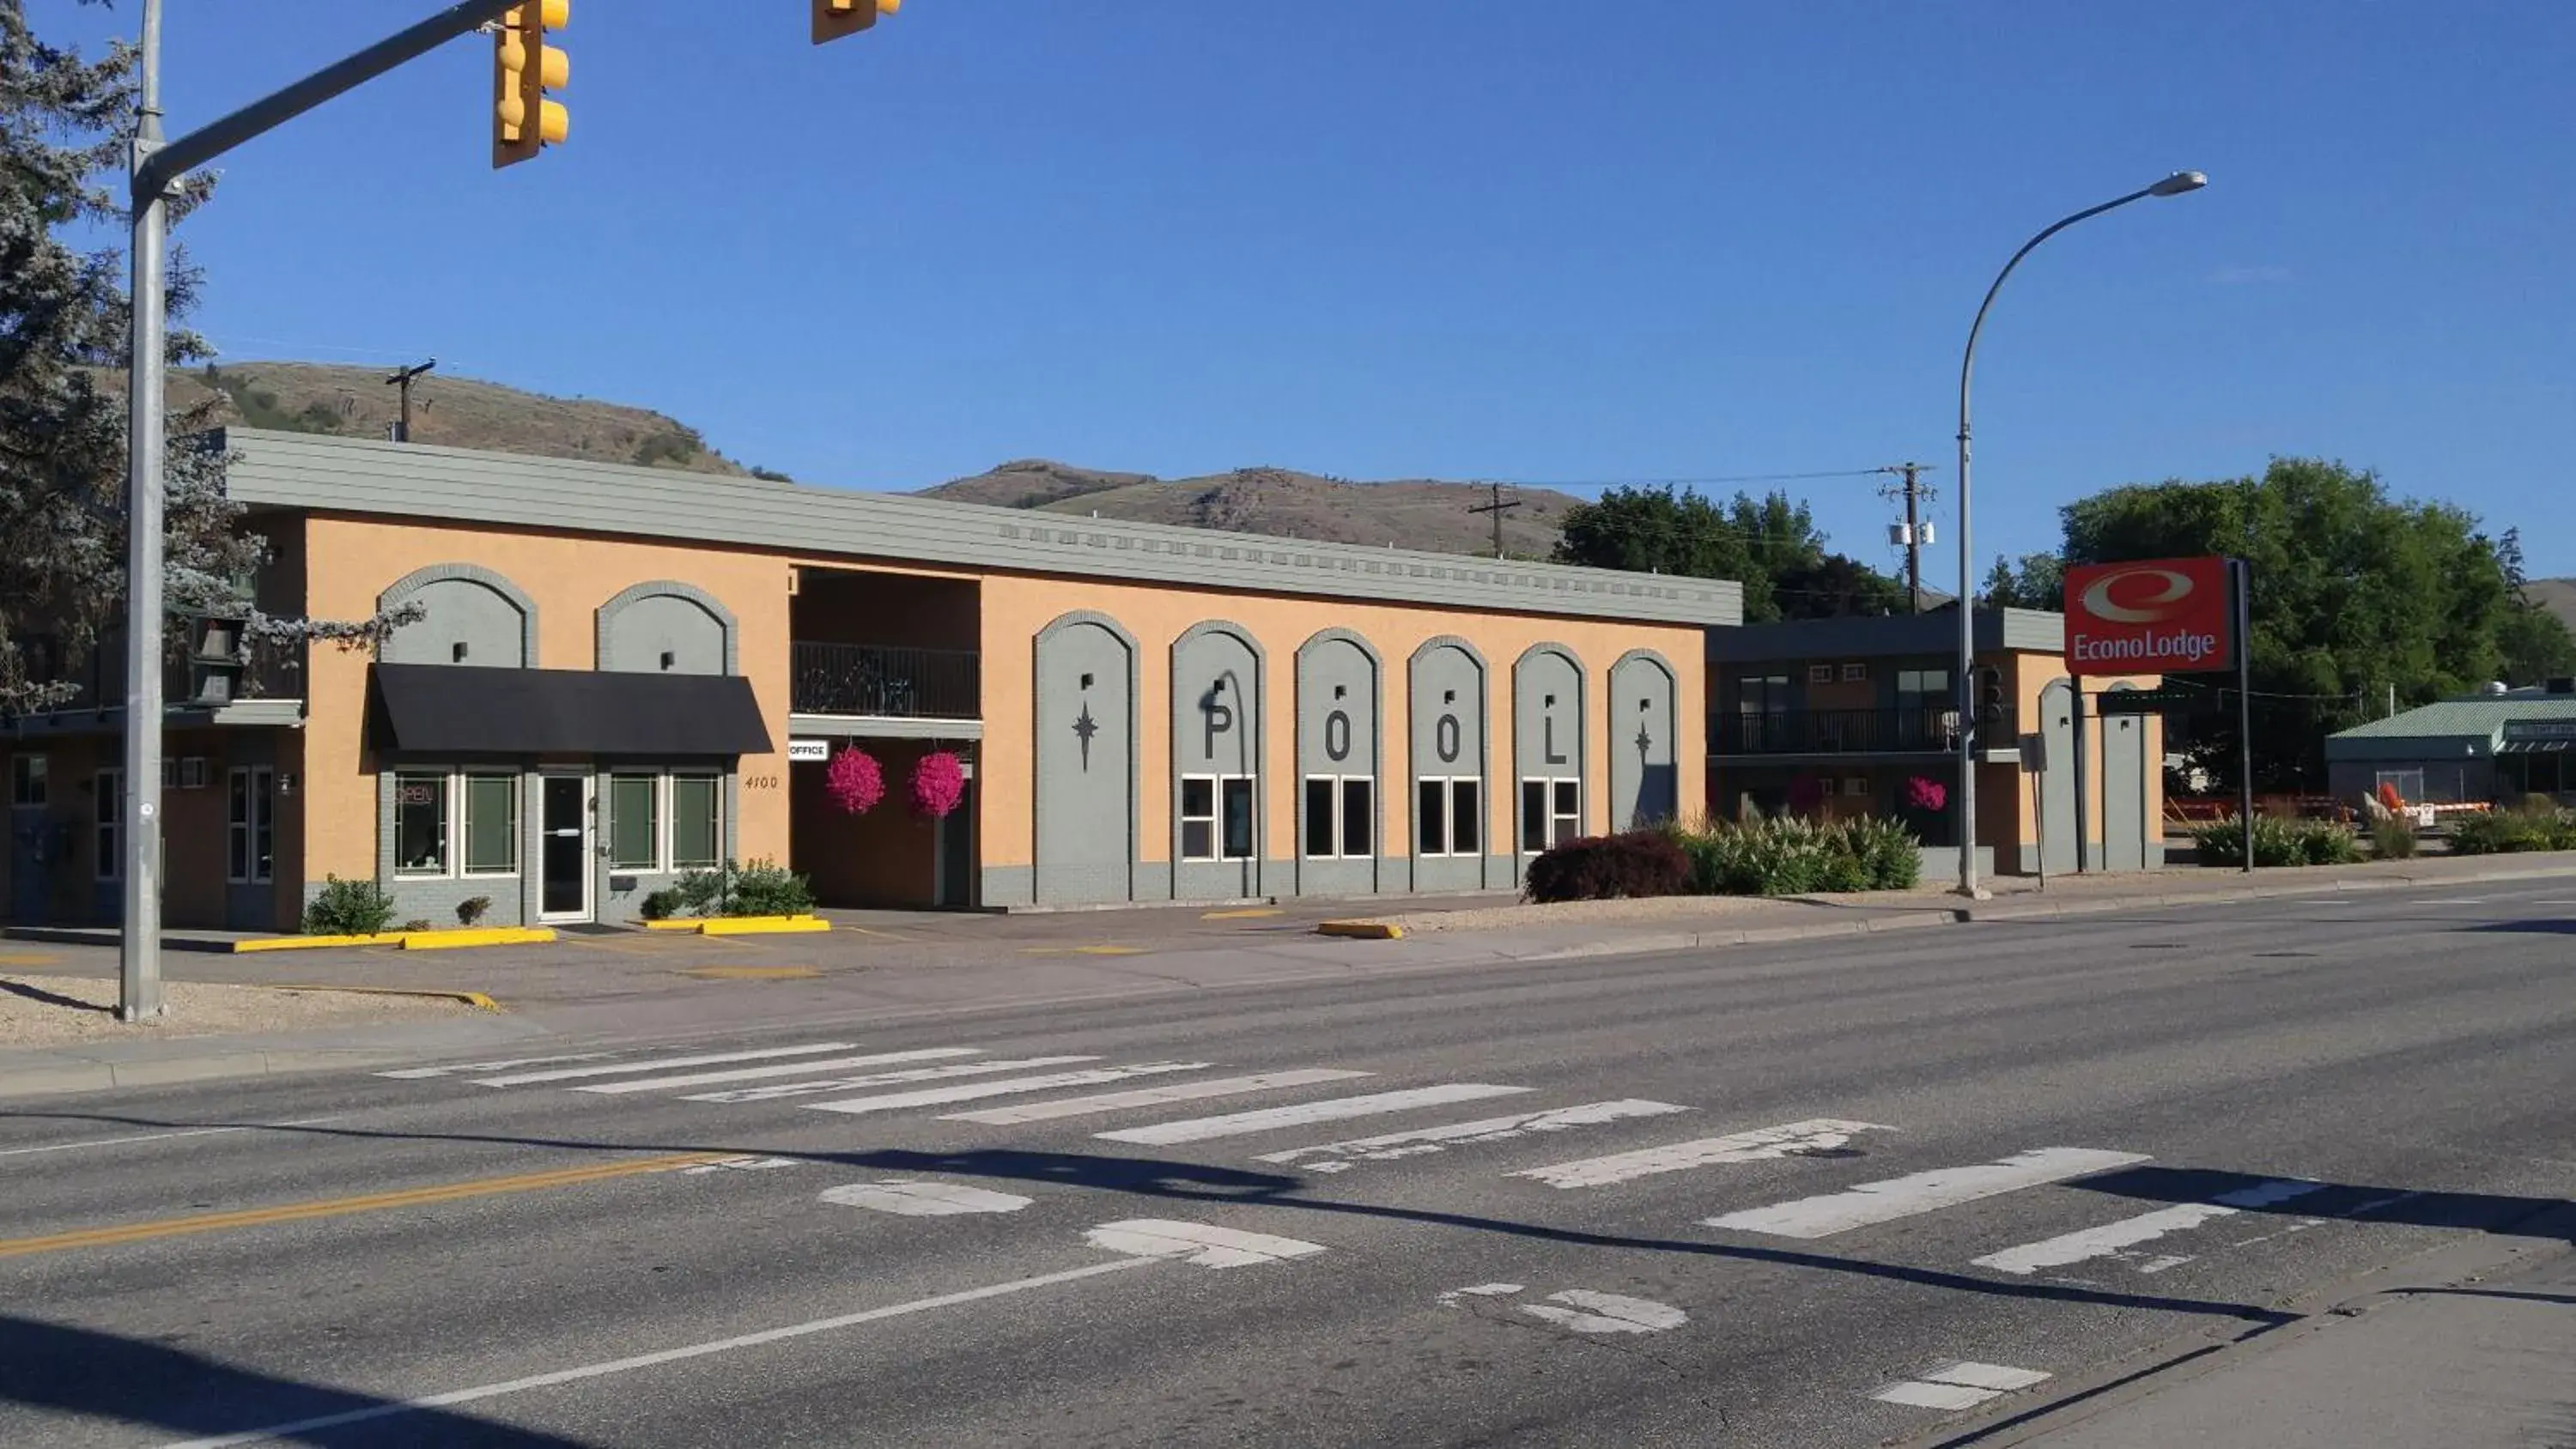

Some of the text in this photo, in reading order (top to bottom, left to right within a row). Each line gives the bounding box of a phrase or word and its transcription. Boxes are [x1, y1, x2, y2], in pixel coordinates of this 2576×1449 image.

[2074, 629, 2215, 661] EconoLodge
[789, 746, 824, 755] OFFICE
[745, 777, 778, 788] 4100
